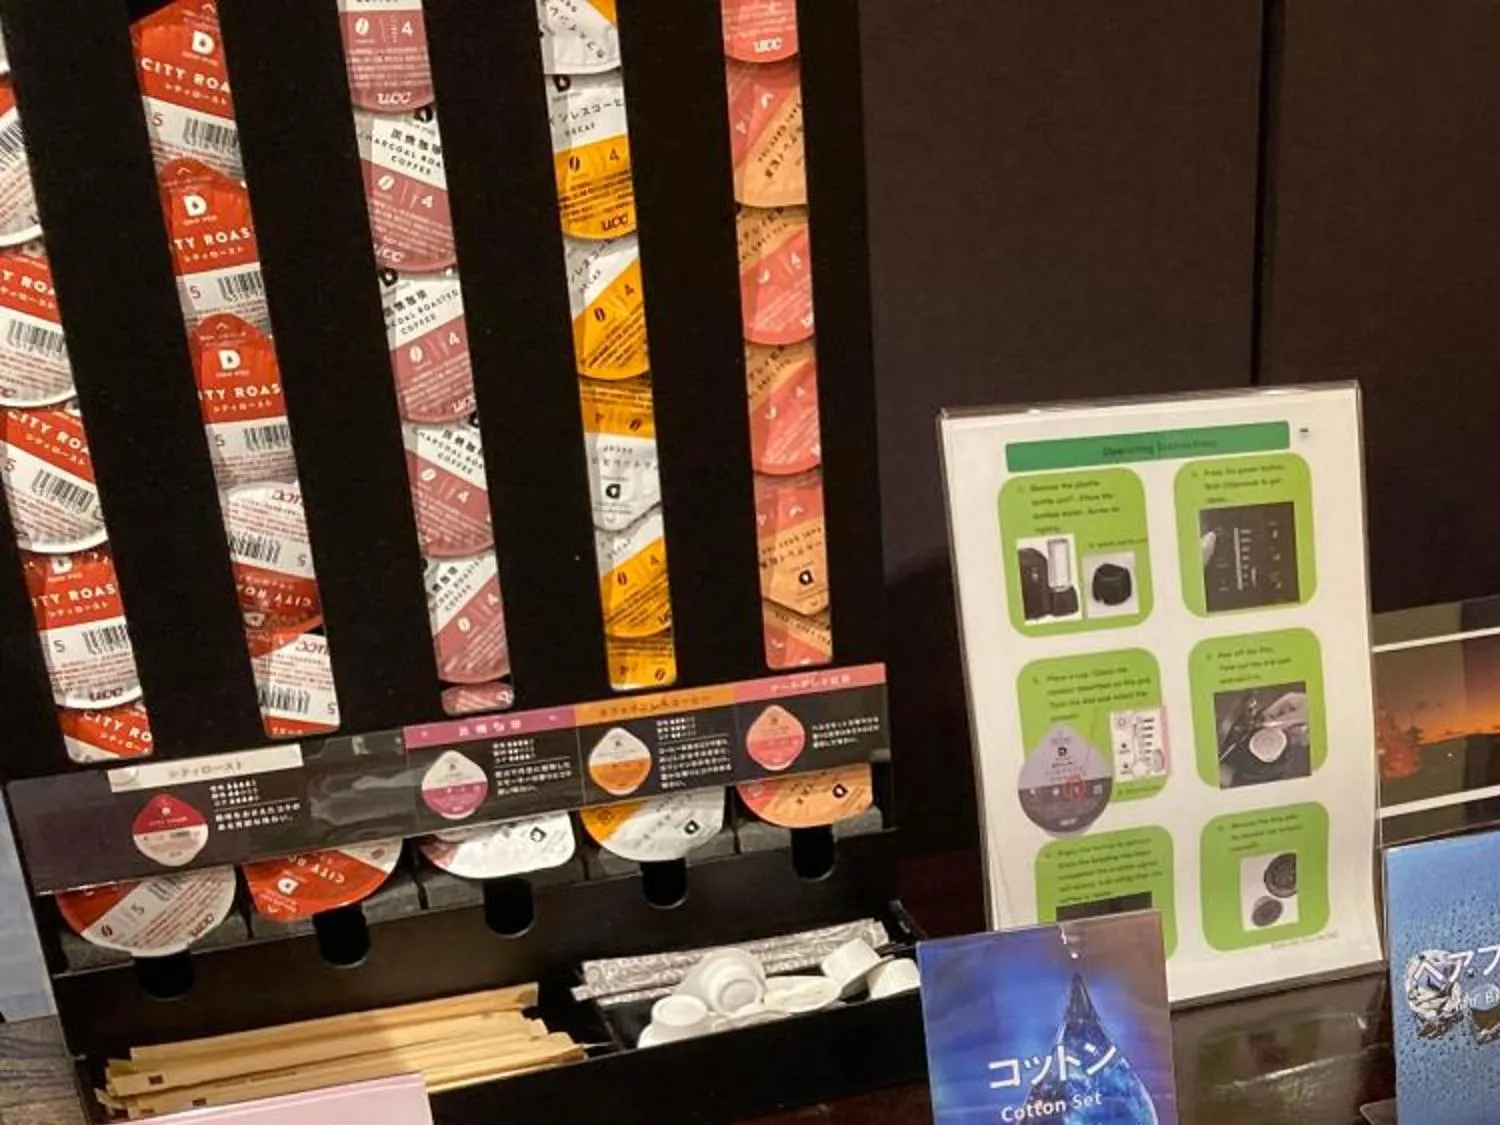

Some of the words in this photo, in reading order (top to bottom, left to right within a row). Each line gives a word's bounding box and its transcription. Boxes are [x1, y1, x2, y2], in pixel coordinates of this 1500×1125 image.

[140, 57, 187, 83] CITY
[987, 1043, 1117, 1090] コットン
[1001, 1099, 1067, 1124] Cotton
[1073, 1091, 1103, 1110] Set
